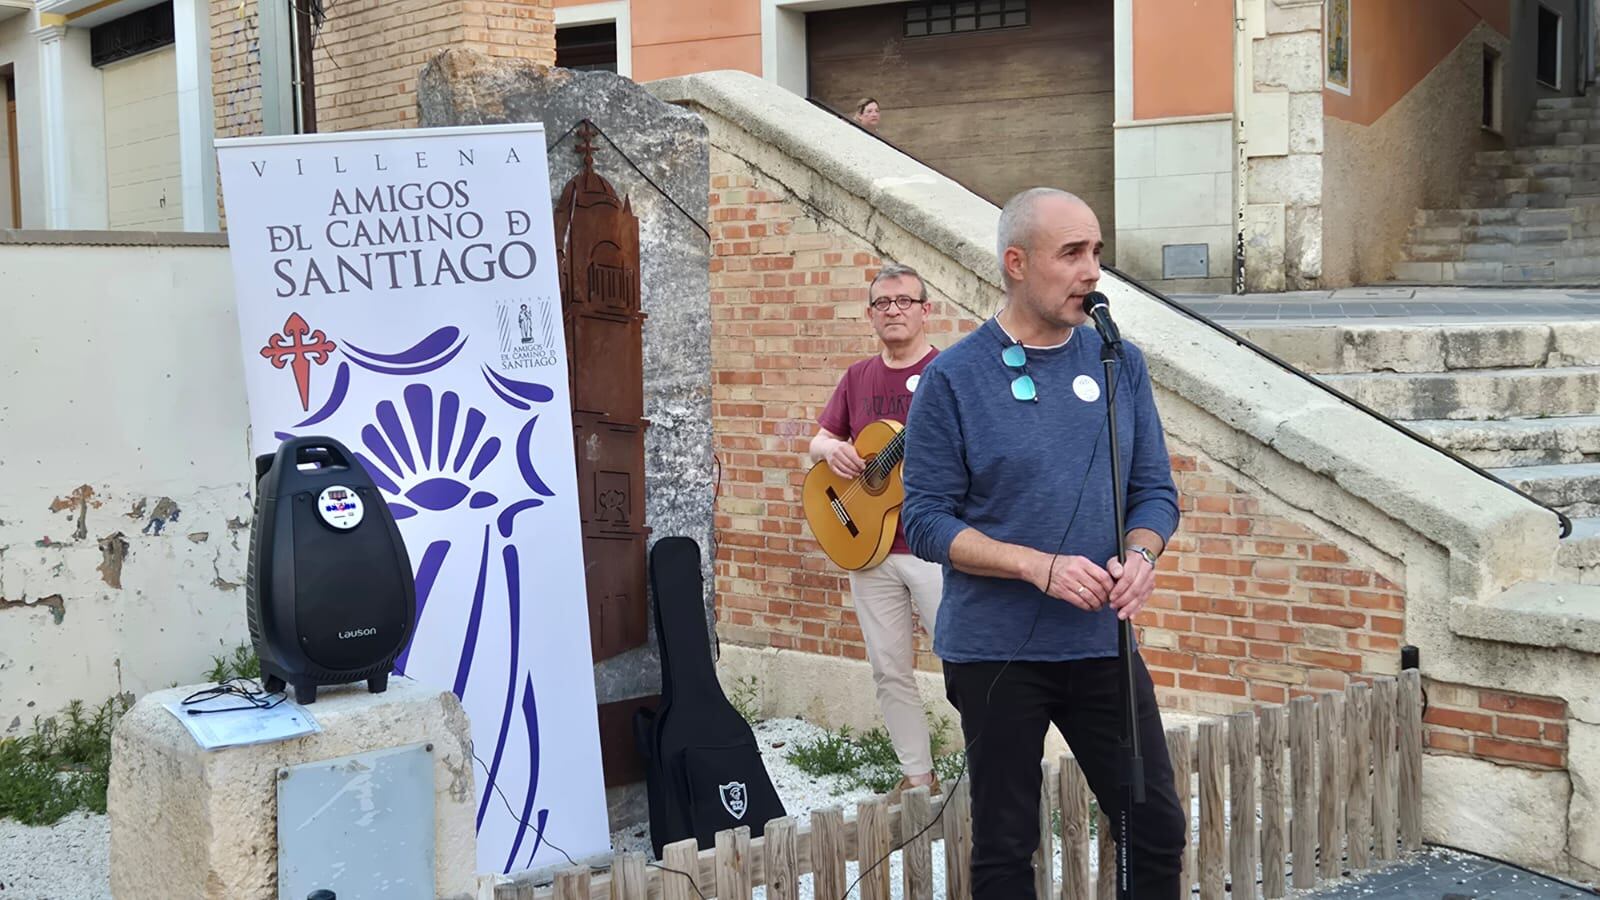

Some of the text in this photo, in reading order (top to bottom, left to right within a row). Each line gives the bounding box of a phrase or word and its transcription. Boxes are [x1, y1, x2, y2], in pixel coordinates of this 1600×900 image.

[251, 147, 521, 178] VILLENA
[328, 179, 470, 216] AMIGOS
[325, 211, 484, 248] CAMINO
[273, 240, 537, 298] SANTIAGO
[502, 356, 557, 370] SANTIAGO
[512, 350, 546, 360] CAMINO
[513, 344, 543, 353] AMIGOS
